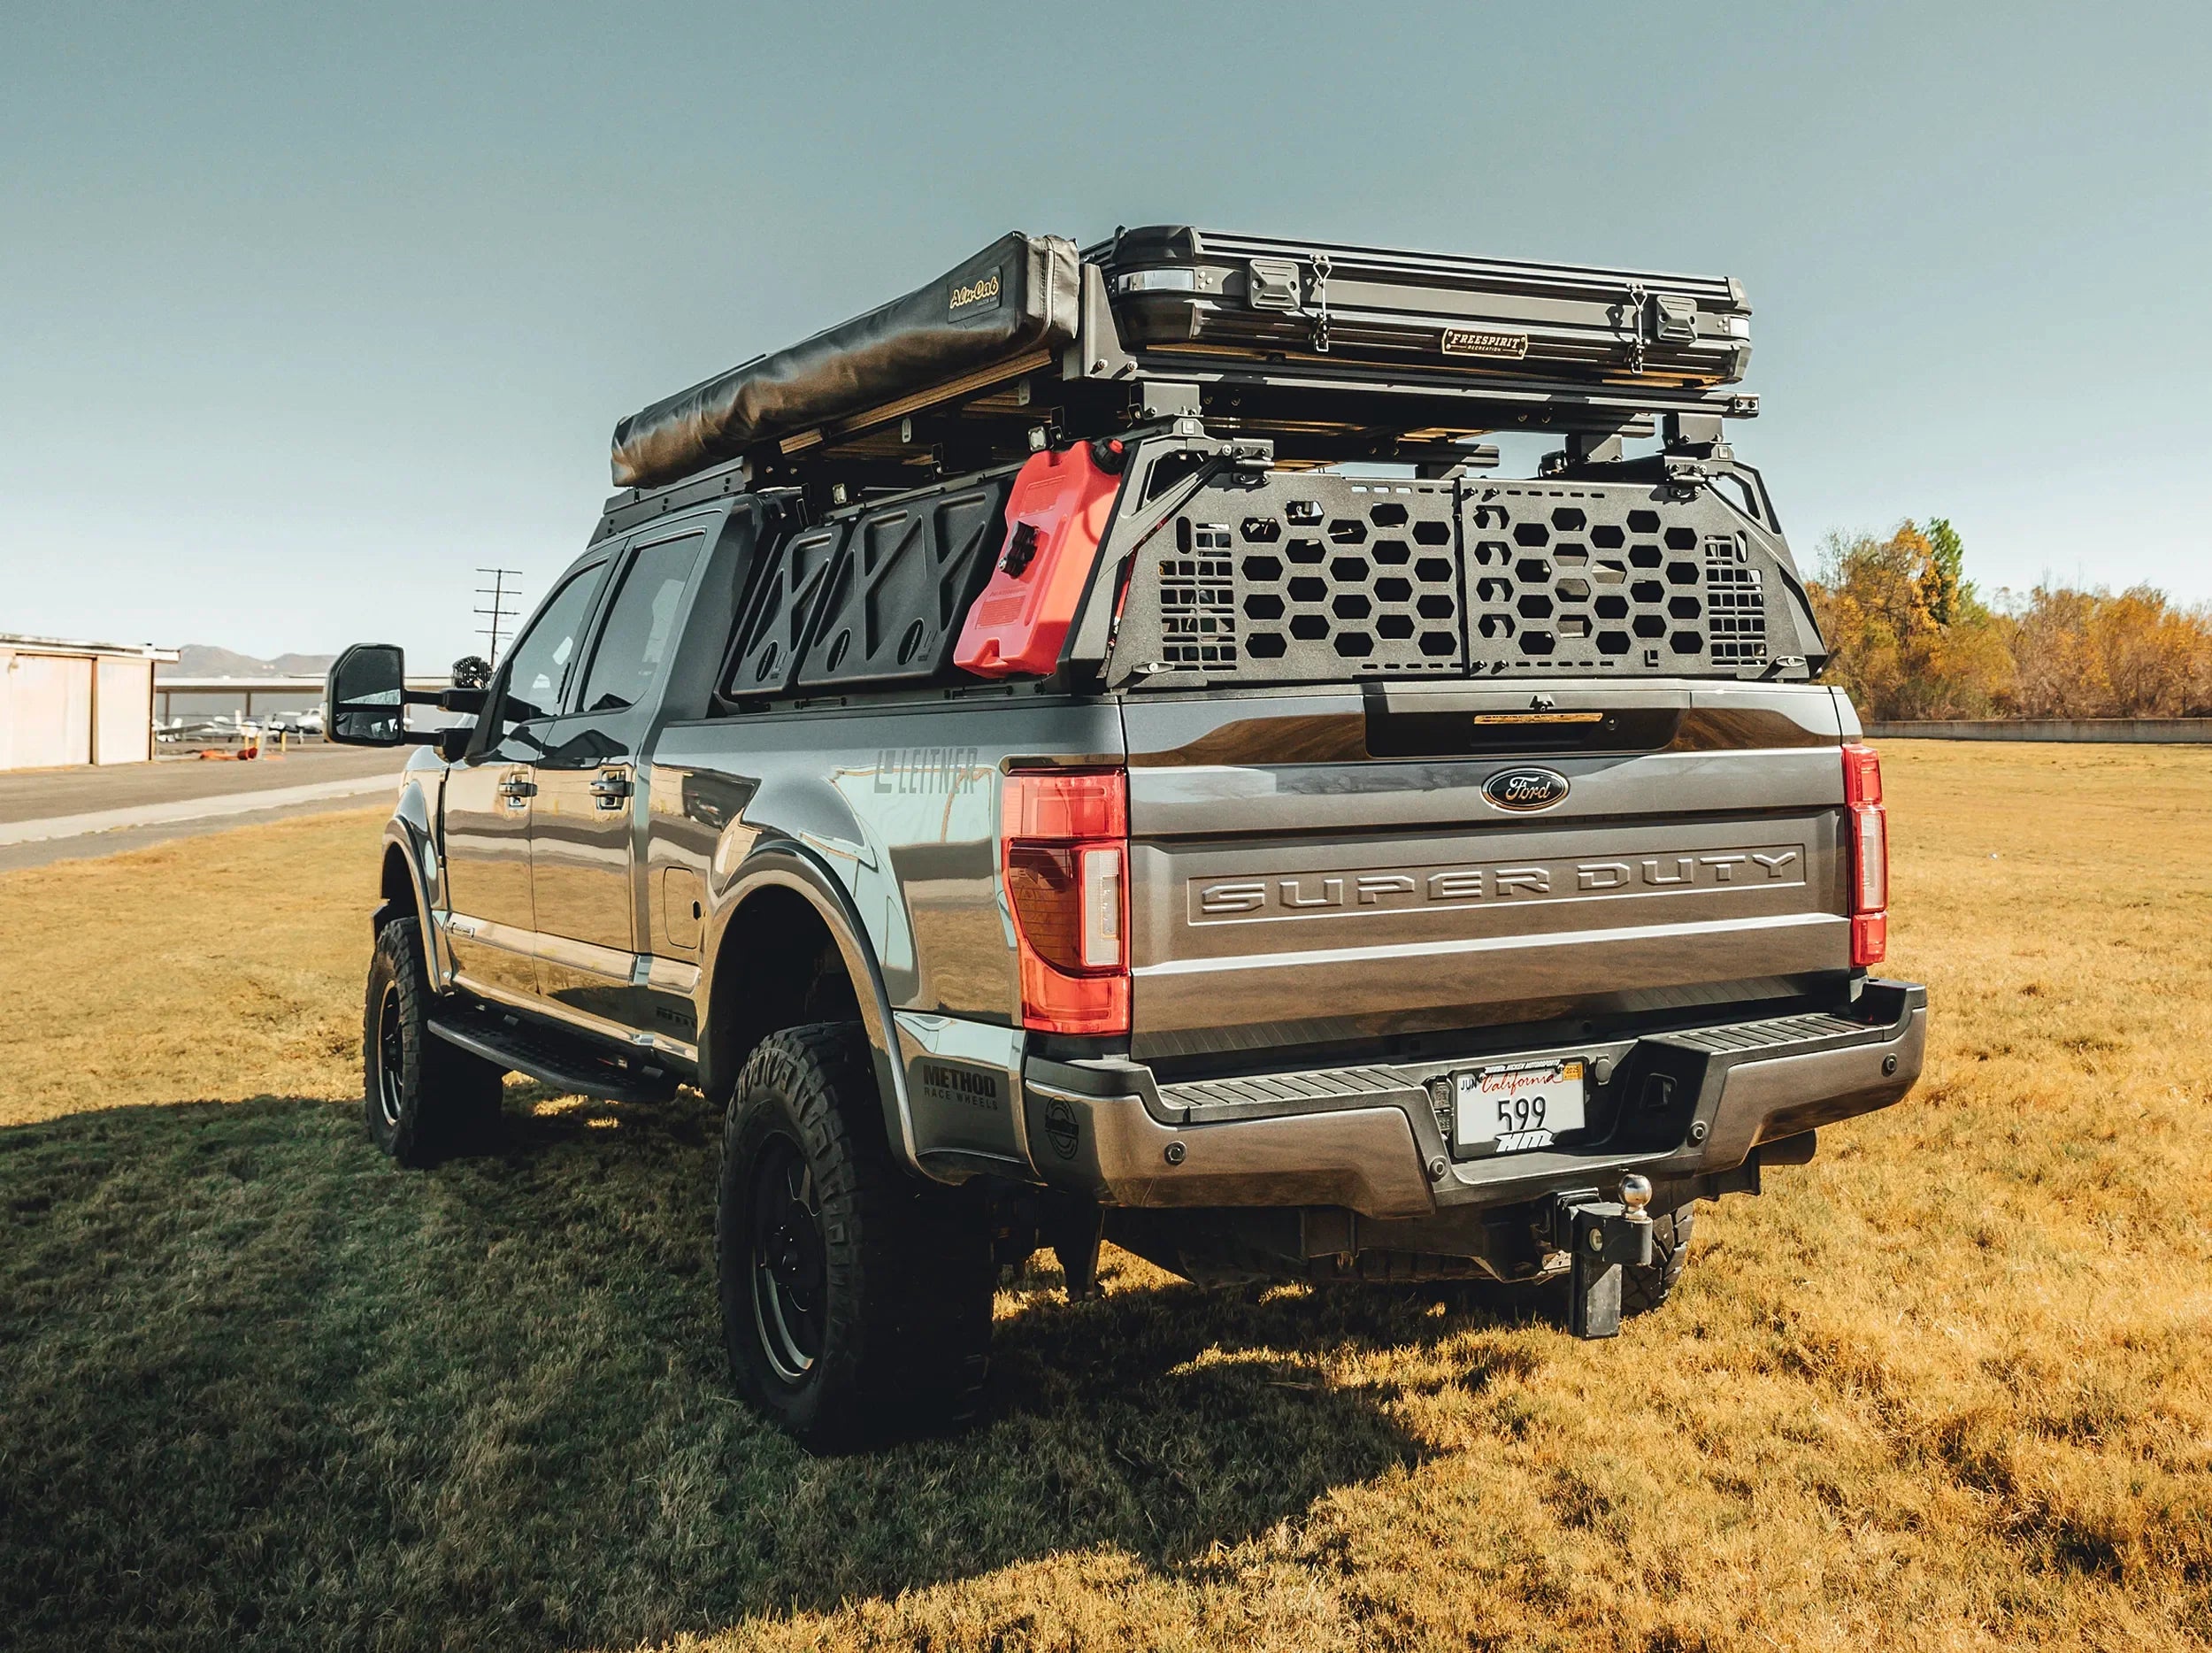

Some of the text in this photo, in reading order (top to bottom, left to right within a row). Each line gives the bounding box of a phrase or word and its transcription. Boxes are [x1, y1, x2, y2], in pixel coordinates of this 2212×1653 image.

[1451, 334, 1520, 349] FREESPIRIT
[898, 747, 979, 794] LEITNER
[1505, 776, 1552, 801] Ford
[1202, 851, 1797, 914] SUPER DUTY
[923, 1065, 996, 1098] METHOD
[1461, 1079, 1478, 1090] JUN
[1481, 1071, 1564, 1096] California
[924, 1087, 998, 1111] RACE WHEELS
[1498, 1096, 1546, 1131] 599
